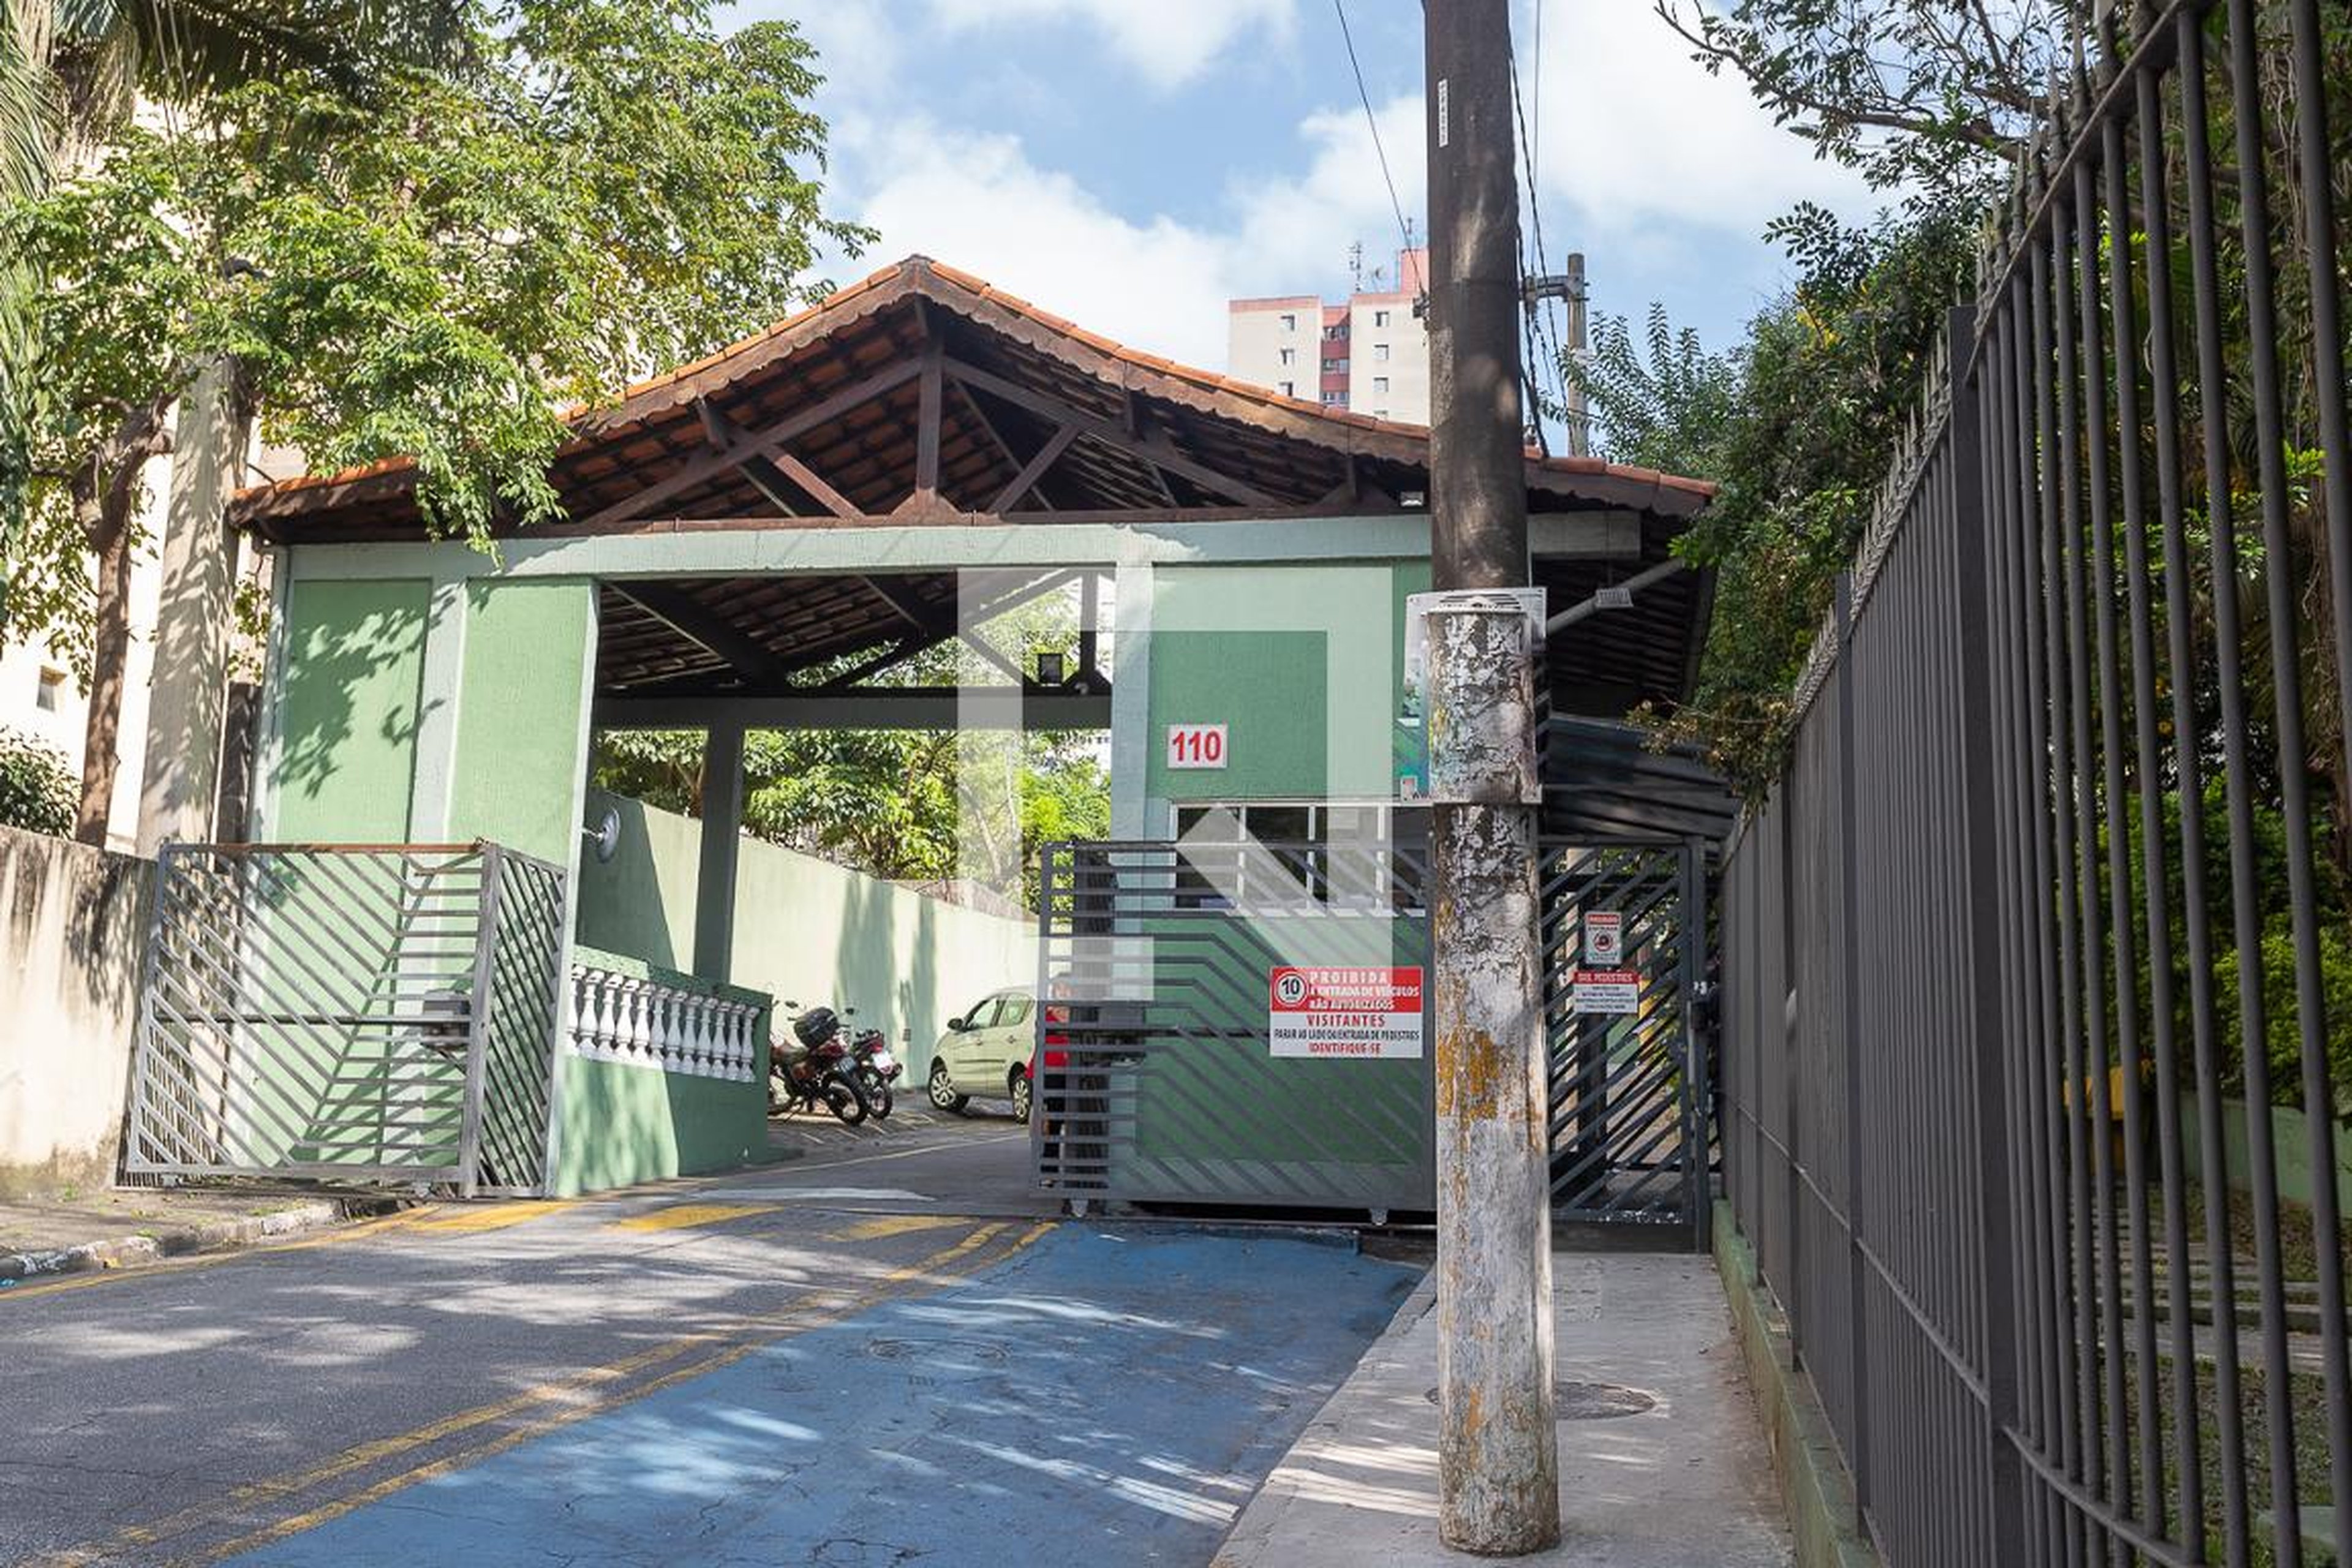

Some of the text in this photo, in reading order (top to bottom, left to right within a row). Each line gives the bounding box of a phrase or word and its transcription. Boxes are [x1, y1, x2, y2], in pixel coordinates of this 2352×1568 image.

[1173, 731, 1221, 761] 110
[1308, 971, 1388, 984] PROIBIDA
[1282, 978, 1300, 995] 10
[1317, 986, 1360, 997] ENTRADA
[1362, 986, 1373, 997] DE
[1331, 1000, 1395, 1010] AUTORIZADOS
[1306, 1014, 1385, 1027] VISITANTES
[1274, 1028, 1297, 1039] PARAR
[1298, 1029, 1307, 1039] AO
[1308, 1029, 1326, 1040] LADO
[1338, 1030, 1370, 1040] ENTRADA
[1371, 1030, 1379, 1040] DE
[1381, 1030, 1420, 1041] PEDESTRES
[1308, 1042, 1381, 1054] IDENTIFIQUE-SE
